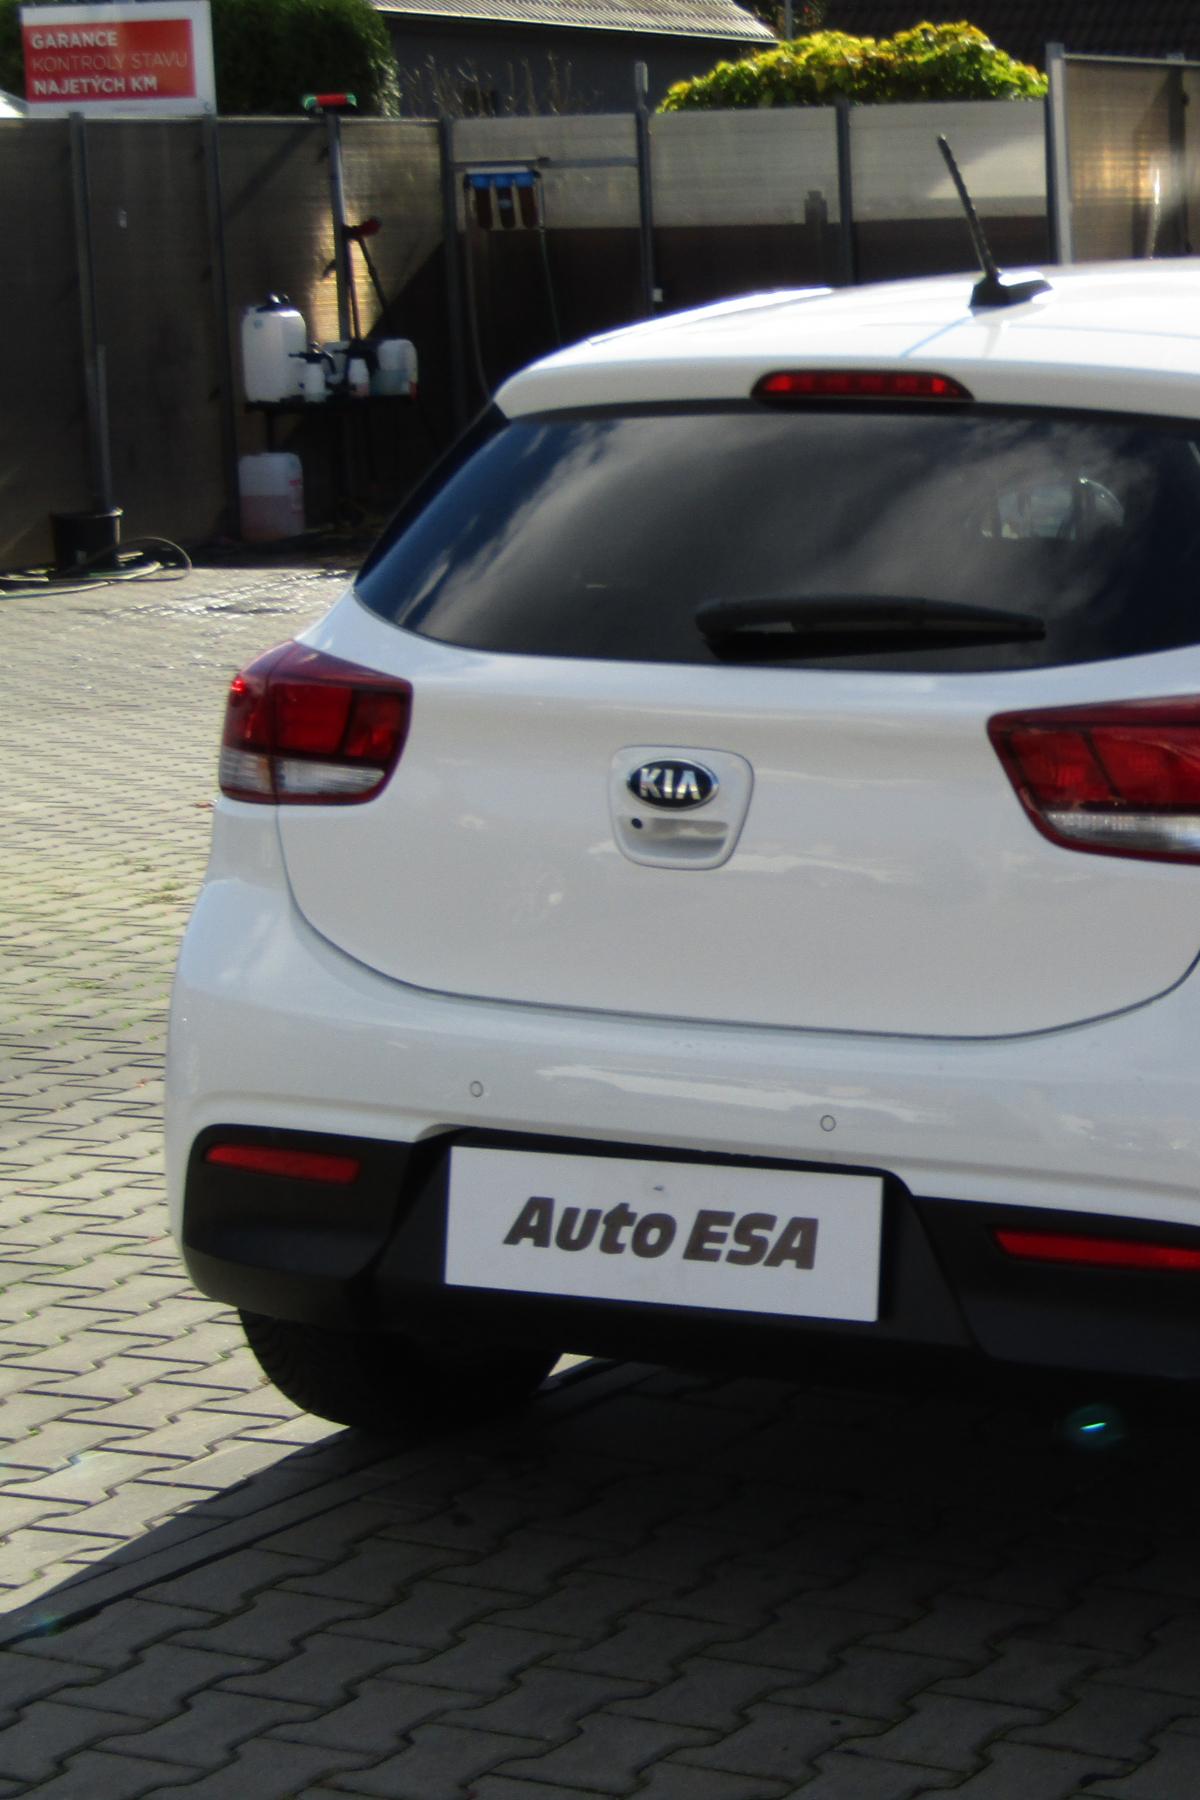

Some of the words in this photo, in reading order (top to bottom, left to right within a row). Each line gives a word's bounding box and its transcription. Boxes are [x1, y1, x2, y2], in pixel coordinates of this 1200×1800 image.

[31, 31, 118, 49] GARANCE
[32, 54, 124, 72] KONTROLY
[131, 51, 188, 68] STAVU
[34, 75, 125, 95] NAJETÝCH
[131, 76, 157, 91] KM
[640, 768, 702, 800] KIA
[503, 1196, 678, 1259] Auto
[682, 1209, 819, 1271] ESA
